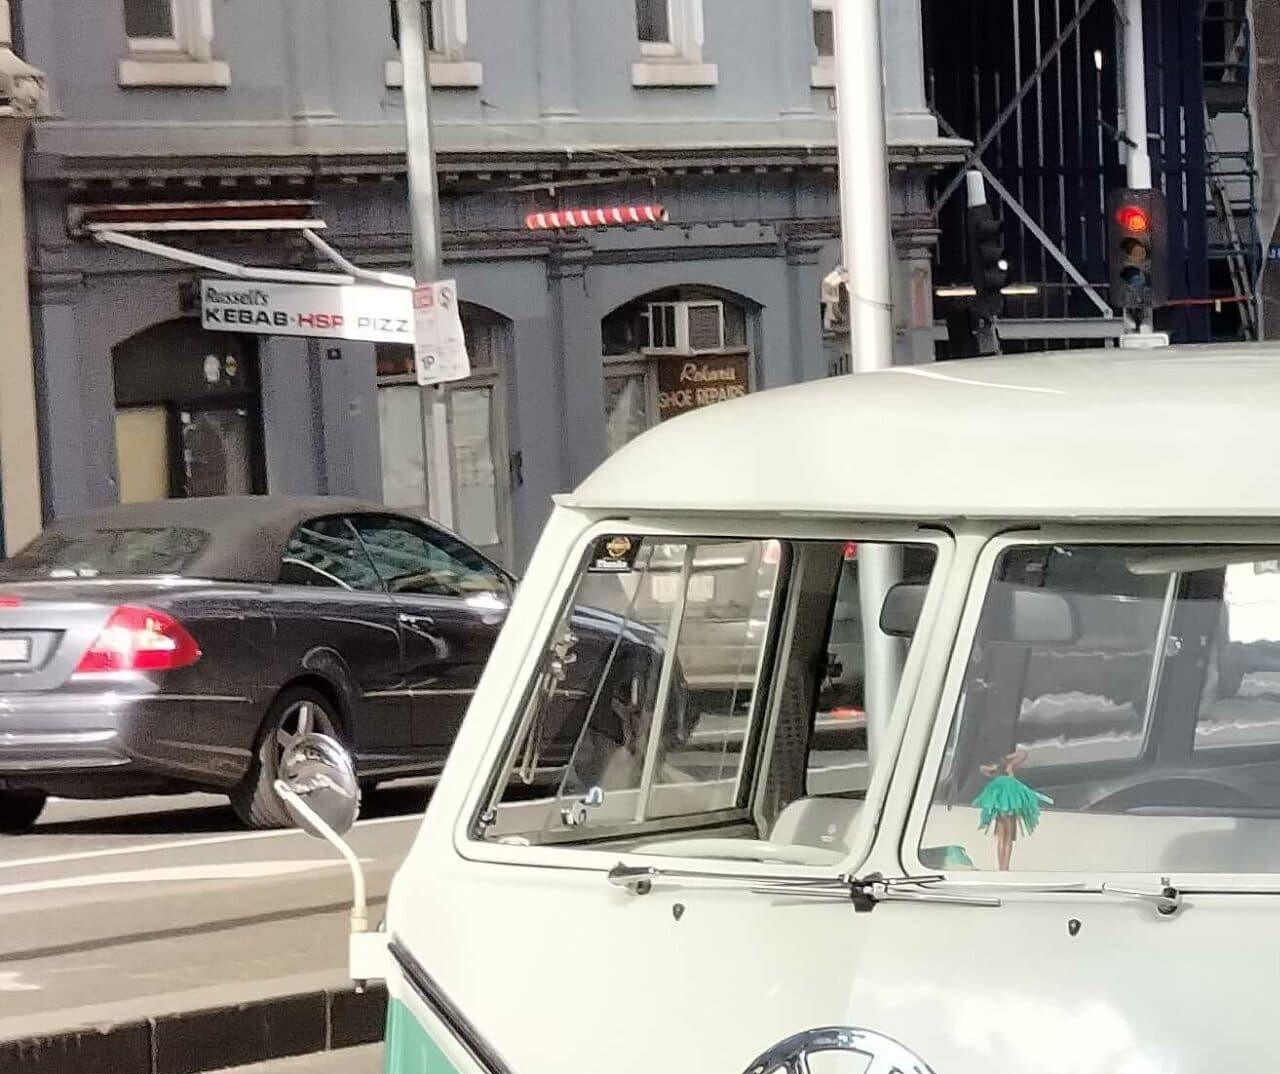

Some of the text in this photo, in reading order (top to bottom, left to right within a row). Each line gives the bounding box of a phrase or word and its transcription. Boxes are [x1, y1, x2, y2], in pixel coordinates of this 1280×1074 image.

[205, 307, 409, 333] KEBAB HSP PIZZ
[660, 387, 694, 409] SHOE
